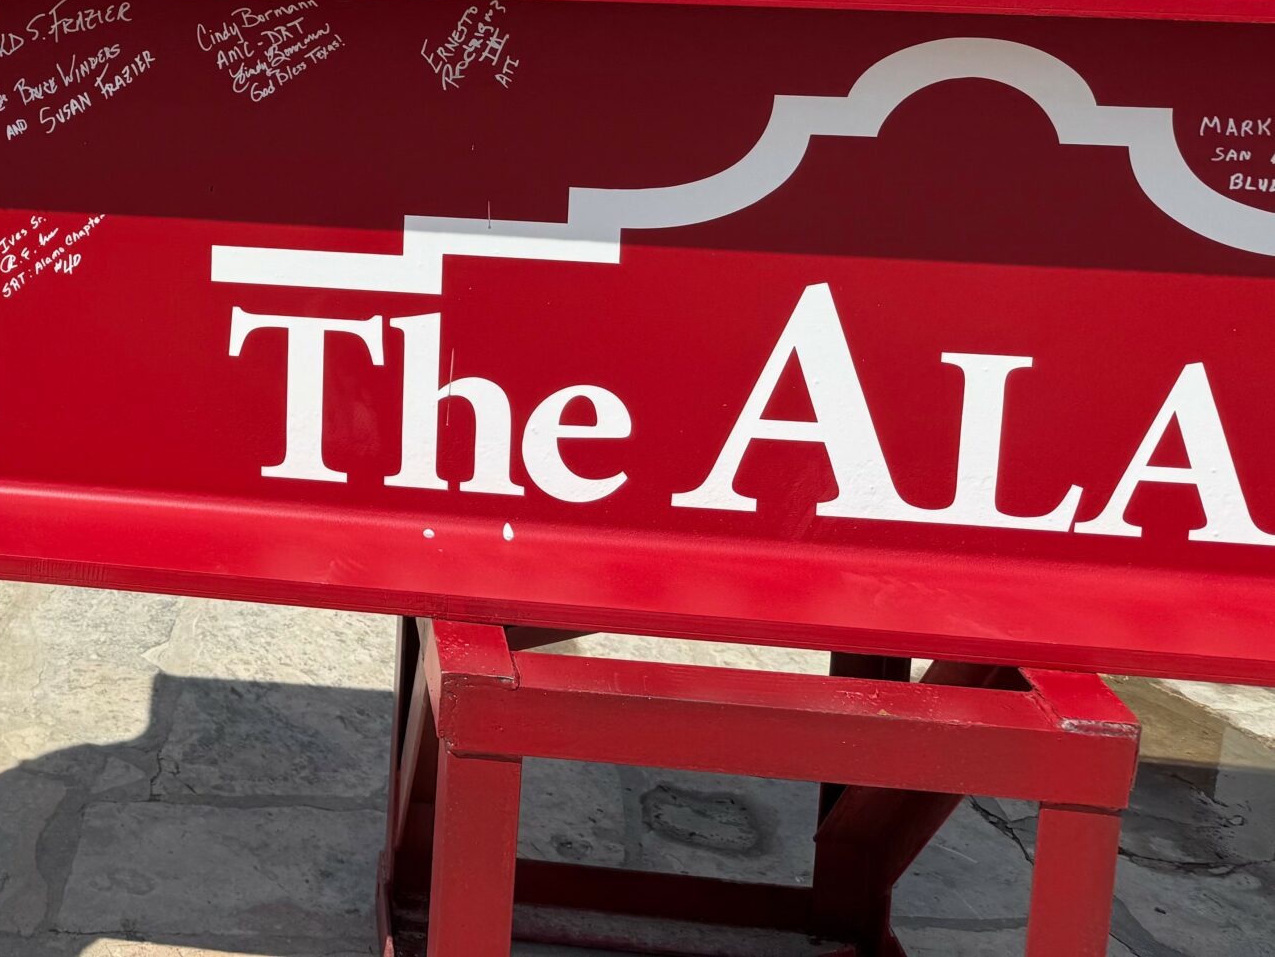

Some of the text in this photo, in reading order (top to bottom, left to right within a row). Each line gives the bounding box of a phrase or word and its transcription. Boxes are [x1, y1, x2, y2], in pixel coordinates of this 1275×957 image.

[196, 22, 245, 52] Cindy
[56, 44, 121, 87] WINDERS
[250, 34, 346, 102] God Bless Texas!
[6, 50, 156, 141] AND SUSAN FRAZIER
[1199, 115, 1272, 137] MARK
[1210, 147, 1252, 161] SAN
[34, 247, 66, 275] Alamo
[65, 213, 106, 246] Chapter
[228, 282, 1275, 547] The ALA
